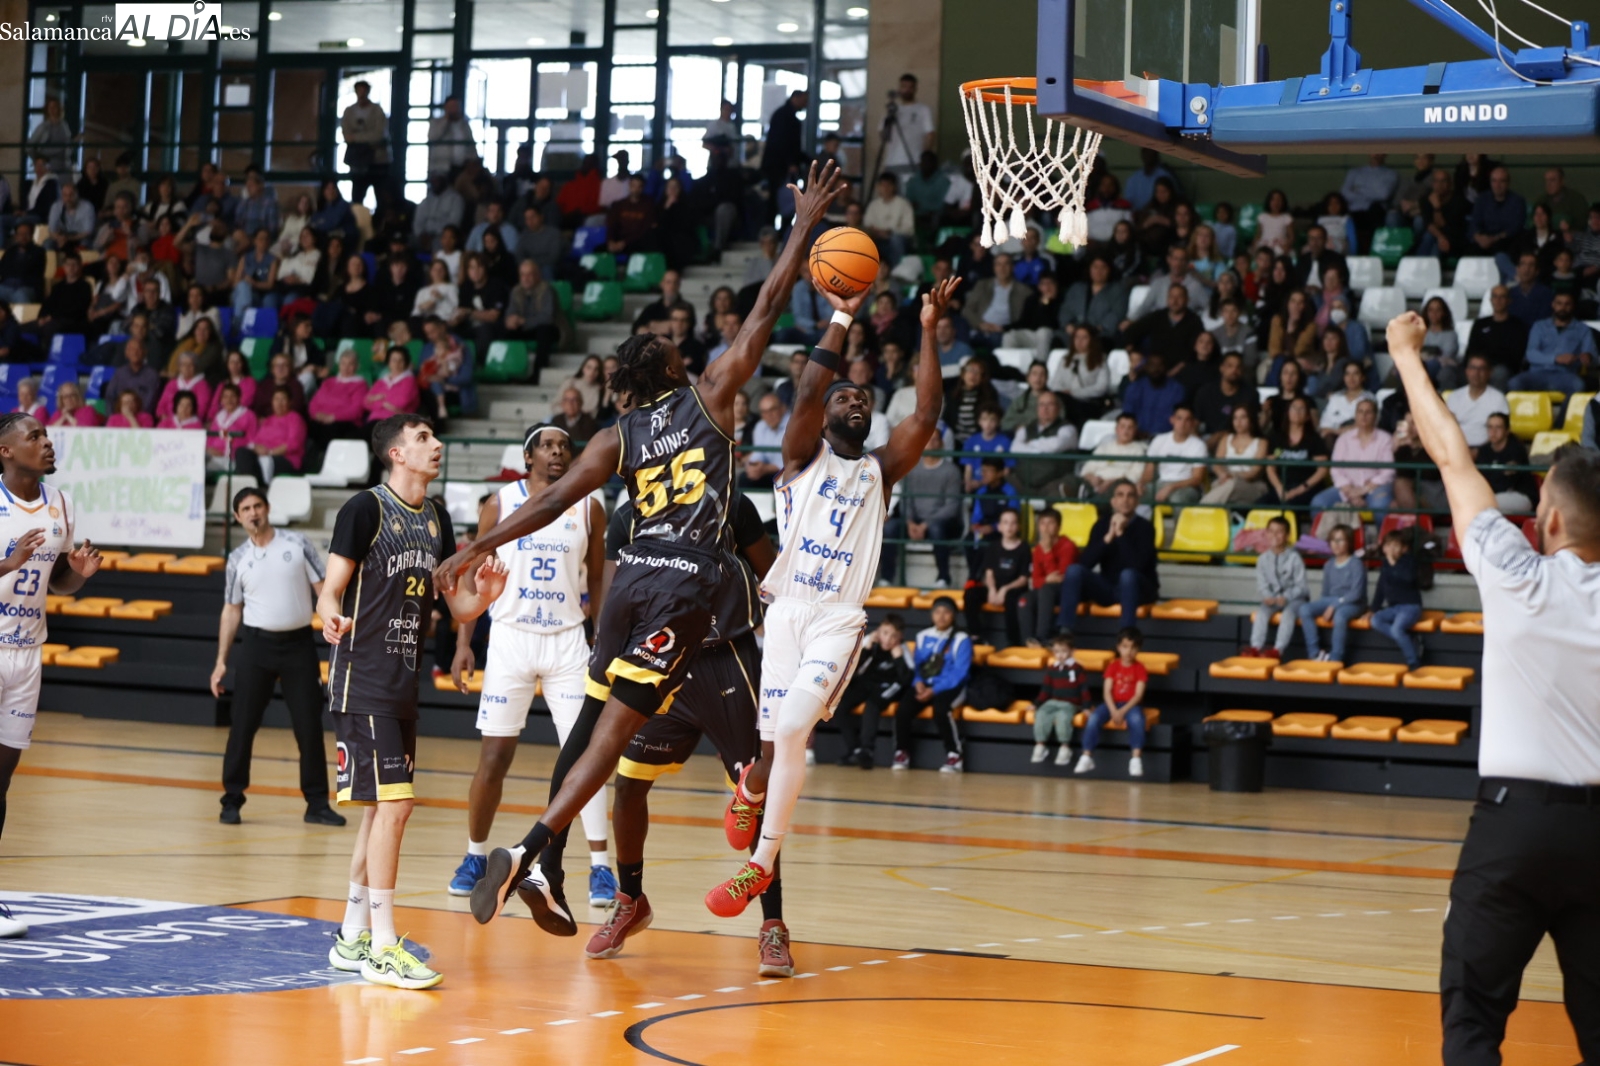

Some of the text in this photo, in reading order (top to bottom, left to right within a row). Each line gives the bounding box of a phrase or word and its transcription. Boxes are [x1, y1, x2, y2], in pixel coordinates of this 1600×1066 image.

[1424, 103, 1508, 123] MONDO
[641, 428, 690, 463] A.DINIS
[635, 447, 707, 518] 55
[829, 508, 846, 538] 4
[387, 549, 437, 577] CARBAJO
[799, 536, 854, 567] Xoborg
[13, 568, 41, 597] 23
[530, 557, 557, 582] 25
[405, 576, 426, 597] 26
[518, 587, 565, 603] Xoborg
